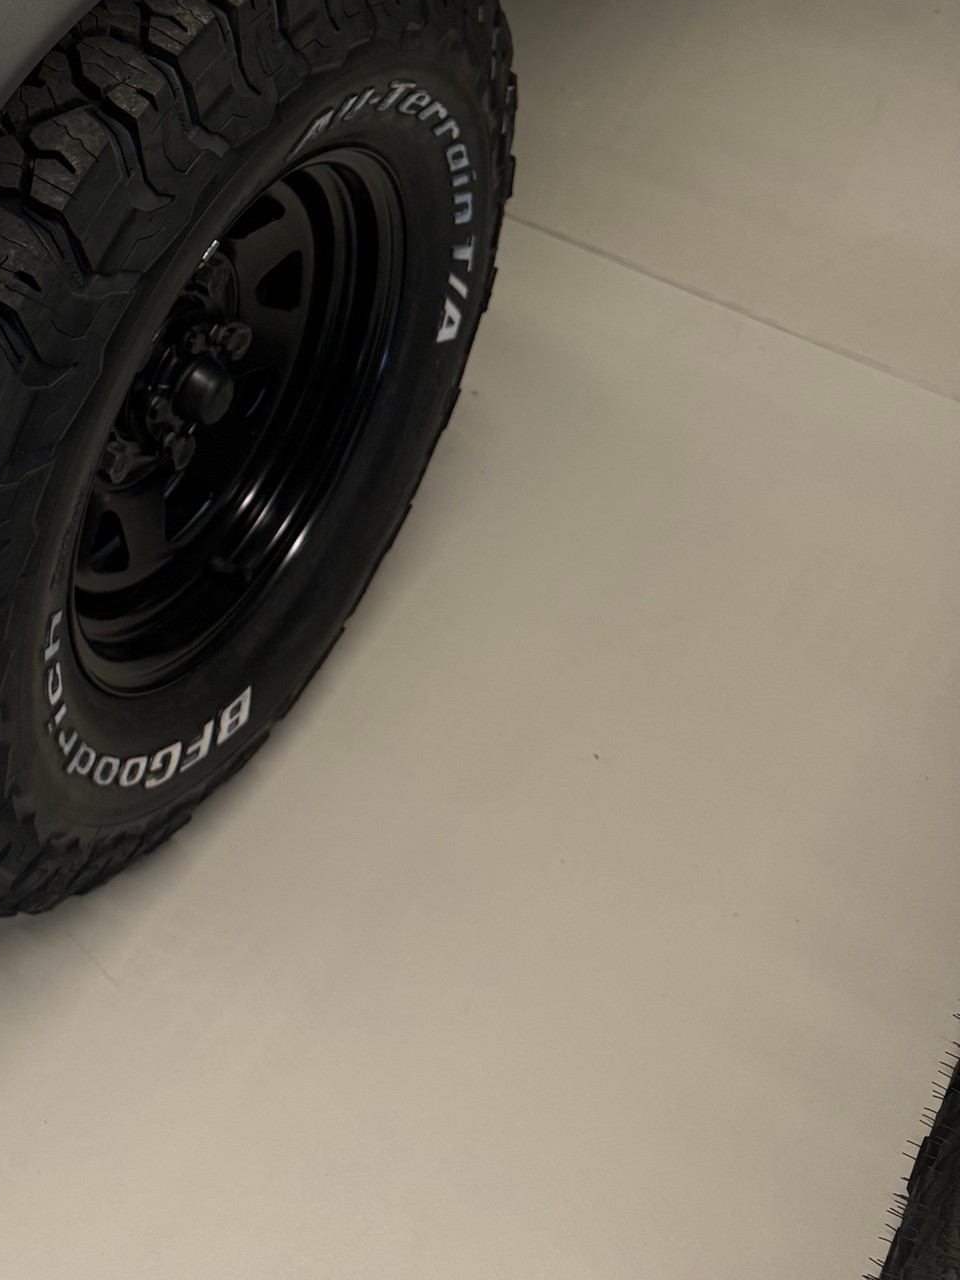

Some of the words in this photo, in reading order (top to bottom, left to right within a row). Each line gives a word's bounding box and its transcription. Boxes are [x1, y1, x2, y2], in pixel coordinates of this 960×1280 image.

[285, 80, 477, 224] All-Terrain
[436, 235, 476, 343] T/A
[45, 609, 252, 789] BFGoodrich
